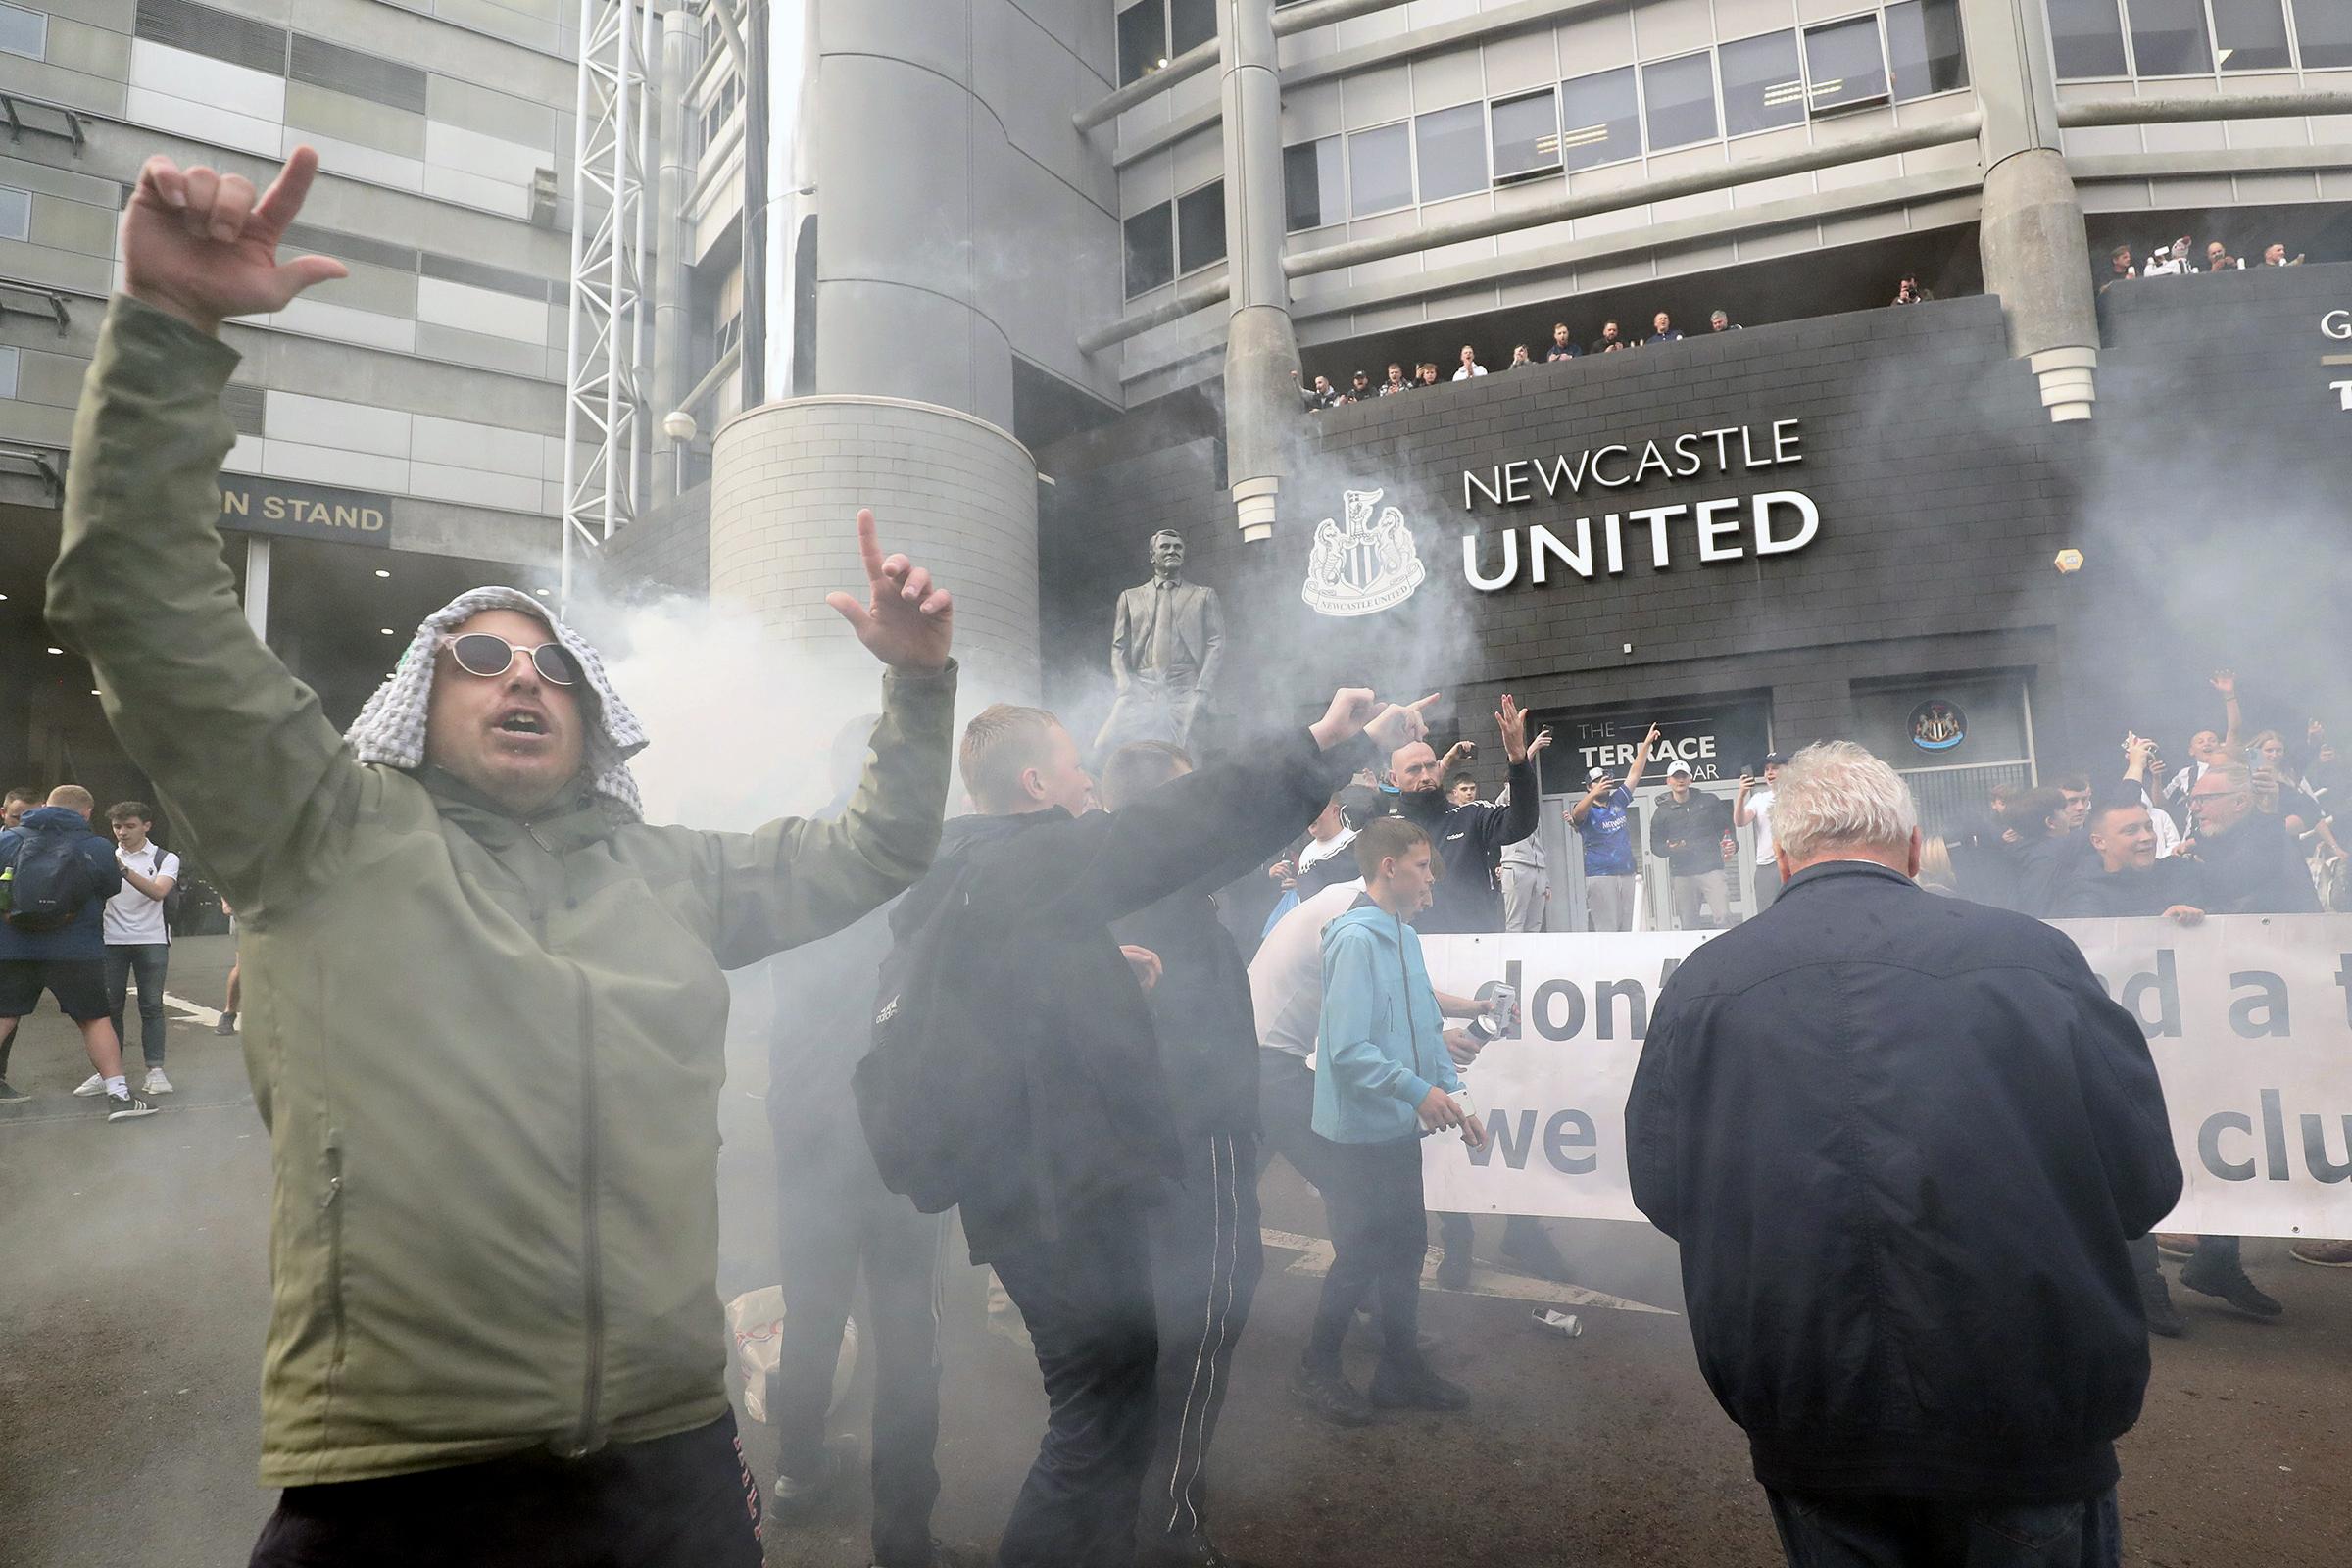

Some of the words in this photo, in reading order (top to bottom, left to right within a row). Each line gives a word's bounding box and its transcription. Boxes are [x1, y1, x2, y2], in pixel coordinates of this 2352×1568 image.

[1463, 418, 1803, 511] NEWCASTLE
[220, 490, 249, 515] N
[263, 496, 384, 531] STAND
[1463, 490, 1820, 591] UNITED
[1321, 600, 1373, 611] NEWCASTLE
[1374, 584, 1408, 606] UNITED
[1577, 721, 1616, 740] THE
[1578, 735, 1717, 768] TERRACE
[1690, 763, 1720, 781] AR
[2093, 949, 2183, 1040] d
[2228, 970, 2291, 1039] a
[1464, 1108, 1598, 1175] we
[2197, 1088, 2352, 1184] clu
